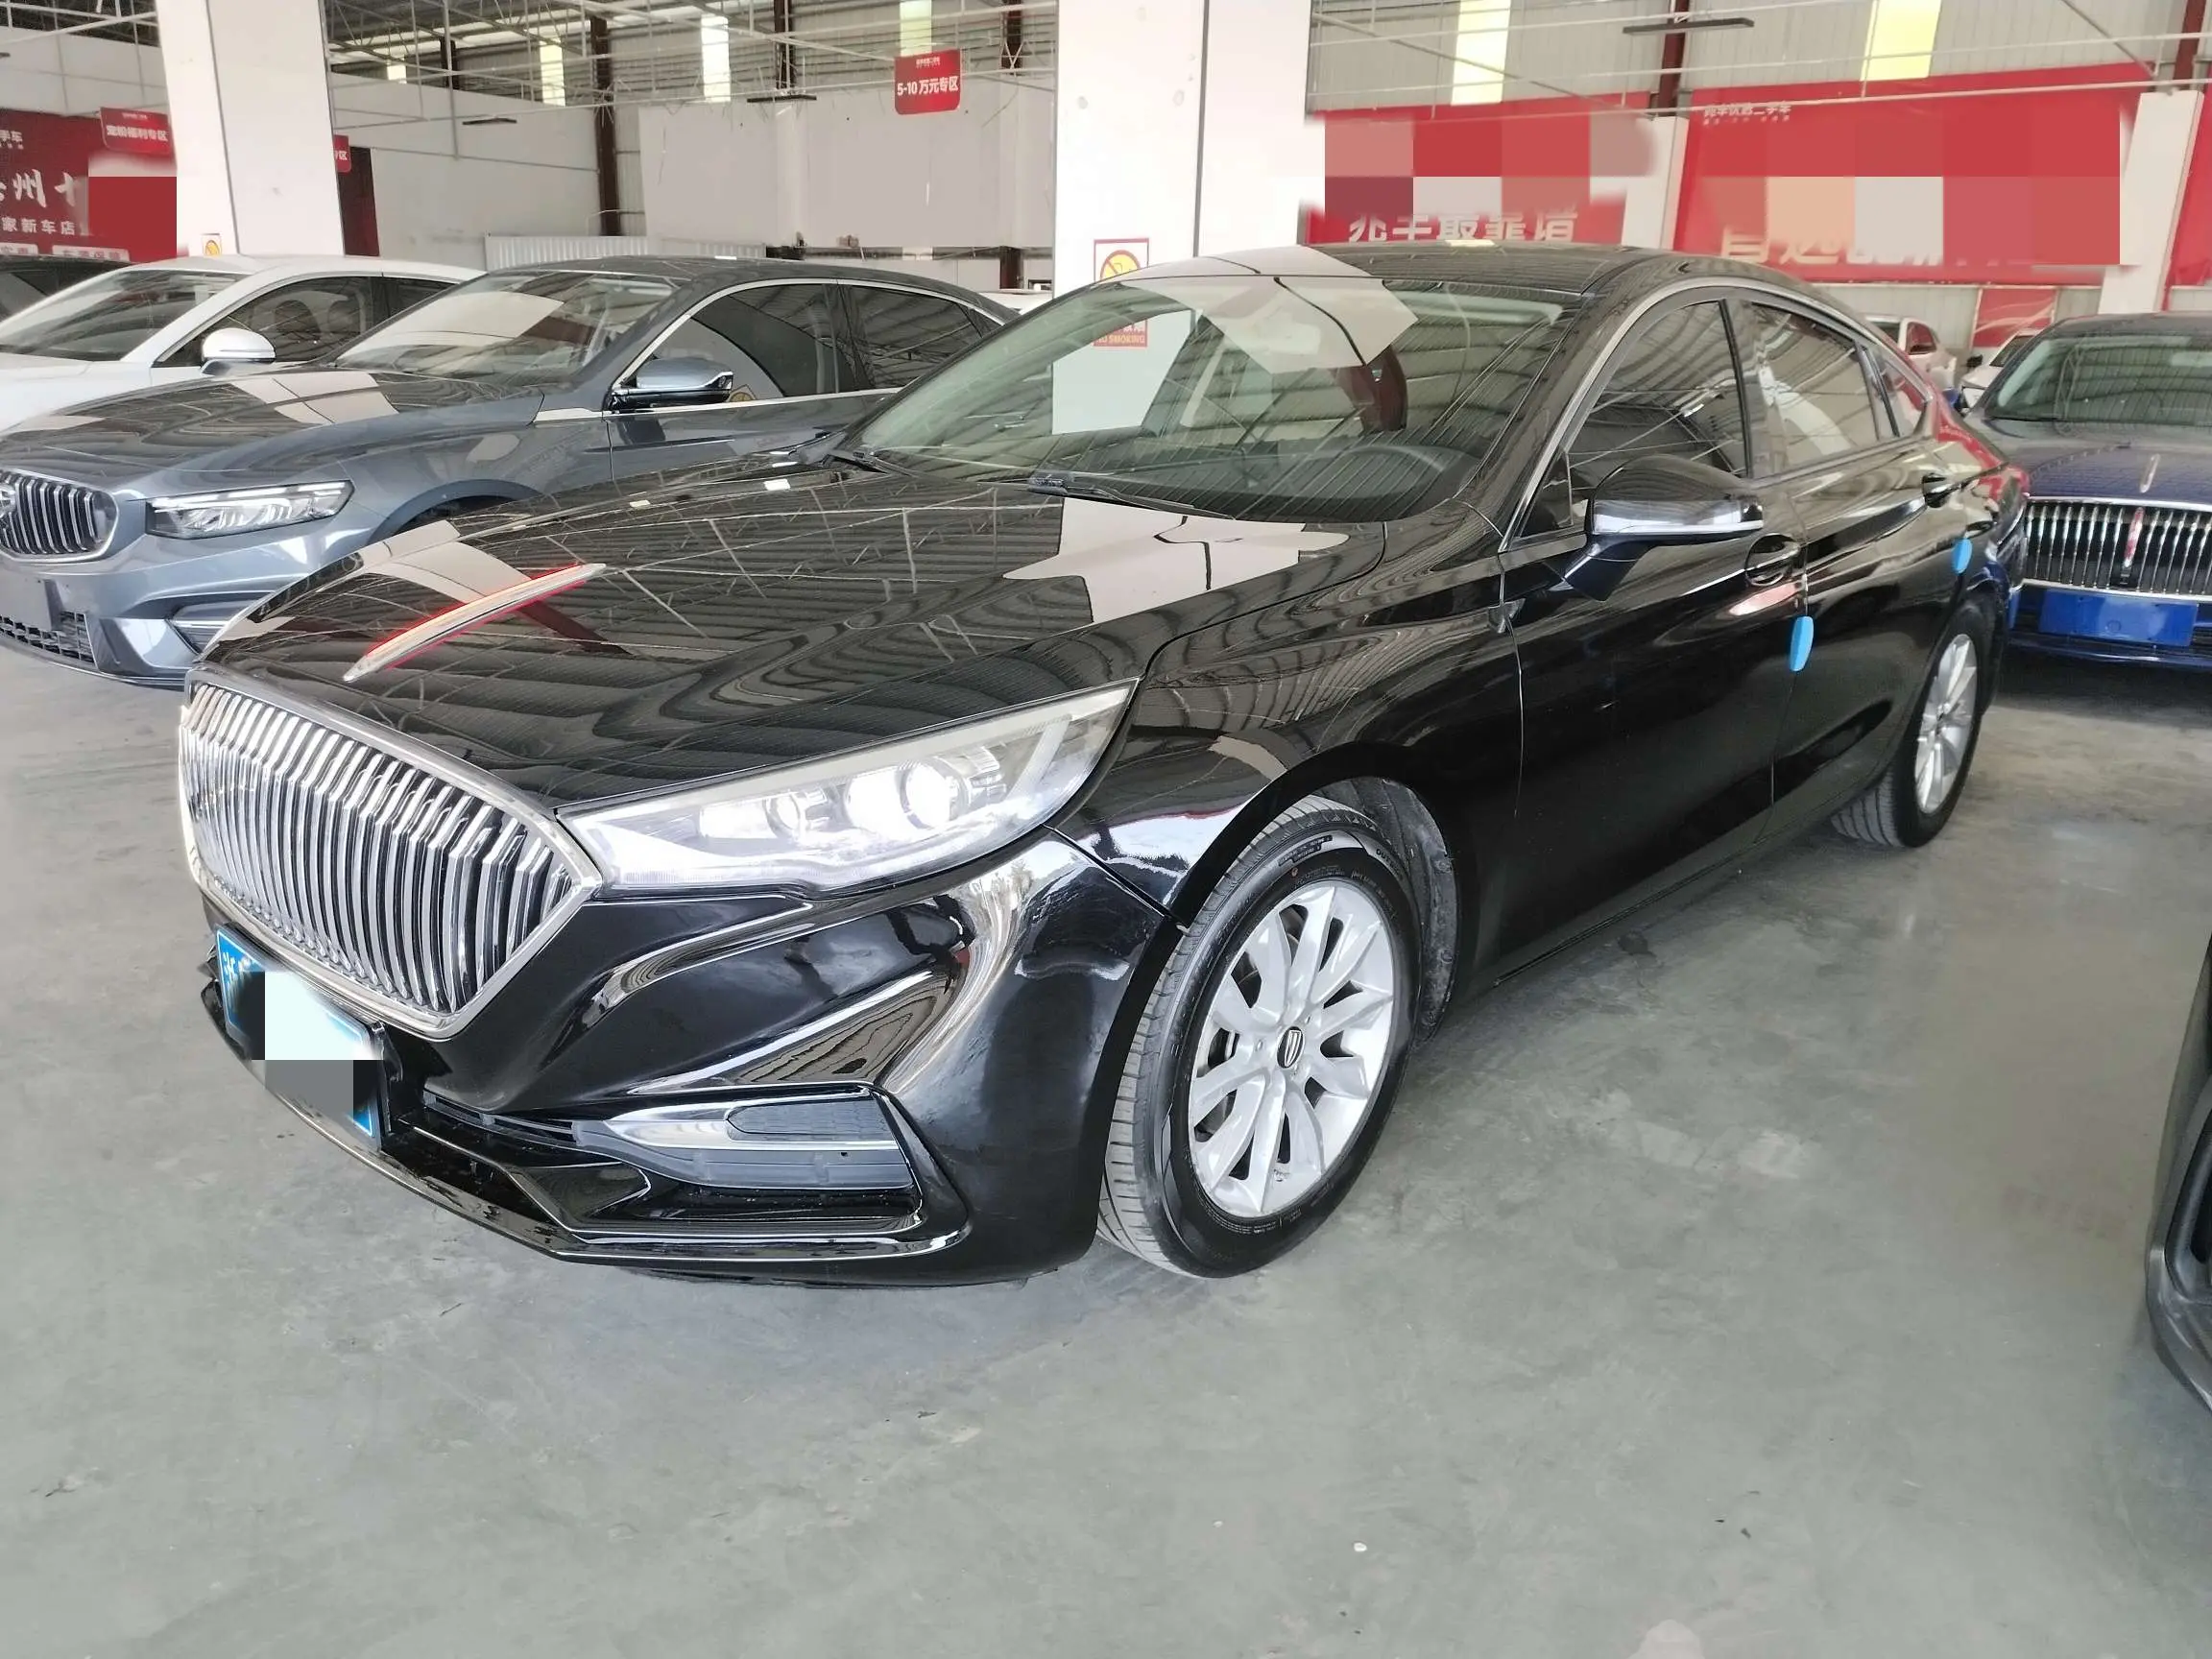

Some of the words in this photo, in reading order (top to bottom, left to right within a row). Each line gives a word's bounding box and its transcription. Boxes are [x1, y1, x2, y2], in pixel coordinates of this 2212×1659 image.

[897, 76, 958, 96] 5-10万元专区
[1109, 334, 1145, 344] SMOKING
